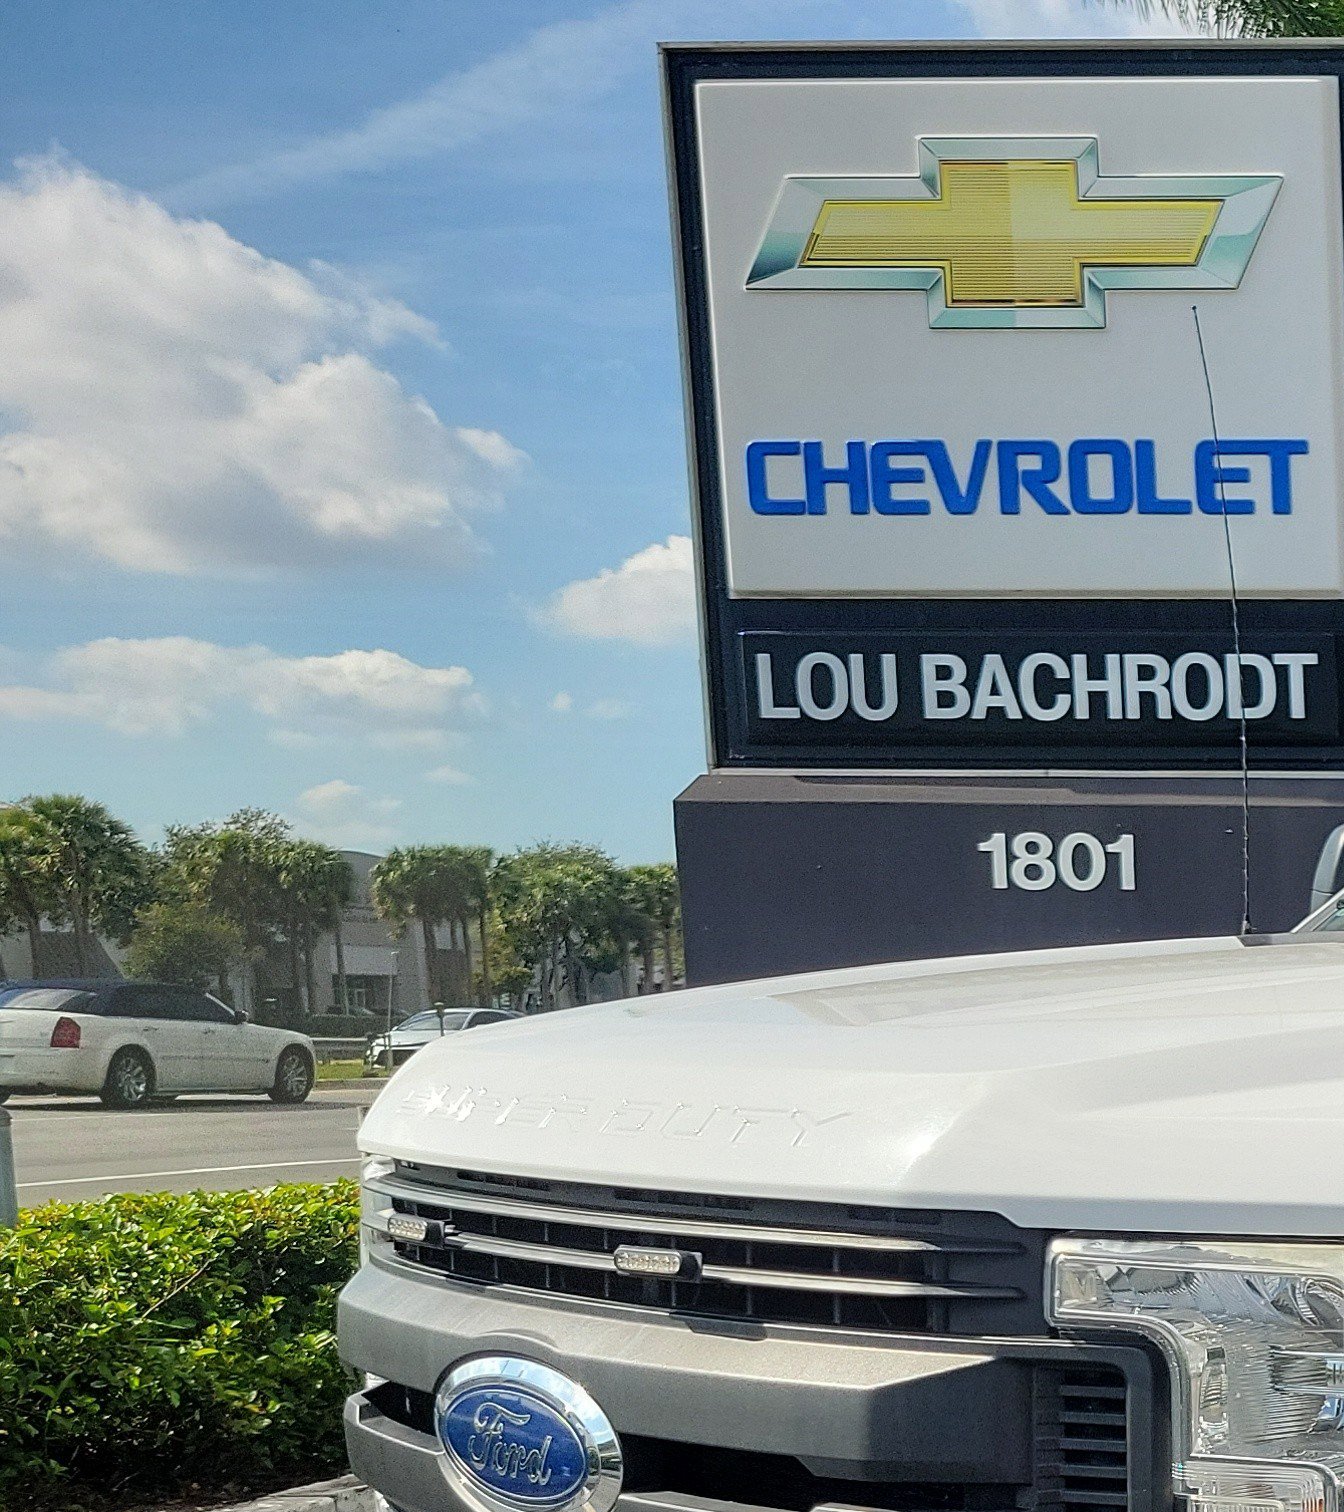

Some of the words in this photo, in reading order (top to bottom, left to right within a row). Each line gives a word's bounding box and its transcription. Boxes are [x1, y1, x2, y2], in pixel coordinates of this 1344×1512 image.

[745, 439, 1310, 517] CHEVROLET
[755, 653, 900, 722] LOU
[923, 653, 1319, 722] BACHRODT
[978, 832, 1138, 892] 1801
[601, 1098, 852, 1148] DUTY
[467, 1402, 553, 1486] Ford
